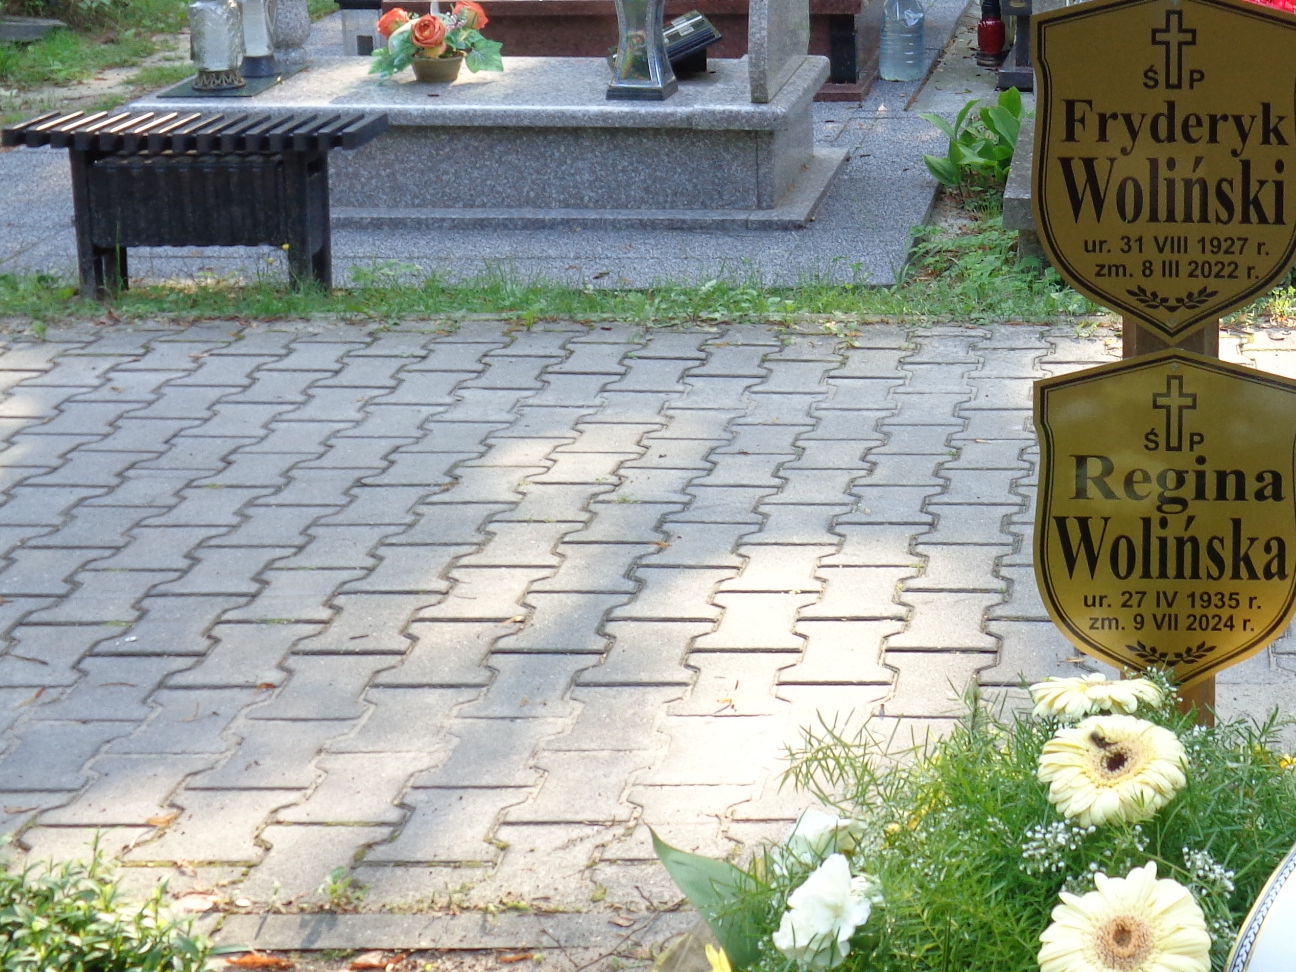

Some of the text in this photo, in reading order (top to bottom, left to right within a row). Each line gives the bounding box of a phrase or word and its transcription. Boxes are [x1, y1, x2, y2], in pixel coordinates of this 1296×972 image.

[1143, 65, 1204, 89] Ś P
[1061, 99, 1289, 157] Fryderyk
[1057, 155, 1286, 225] Woliński
[1084, 236, 1269, 255] ur. 31 VIII 1927 r.
[1095, 260, 1259, 279] zm. 8 III 2022 r.
[1144, 428, 1204, 452] Ś P
[1070, 455, 1286, 514] Regina
[1053, 515, 1288, 581] Wolińska
[1084, 591, 1261, 609] ur. 27 IV 1935 r.
[1089, 613, 1254, 631] zm. 9 VII 2024 r.
